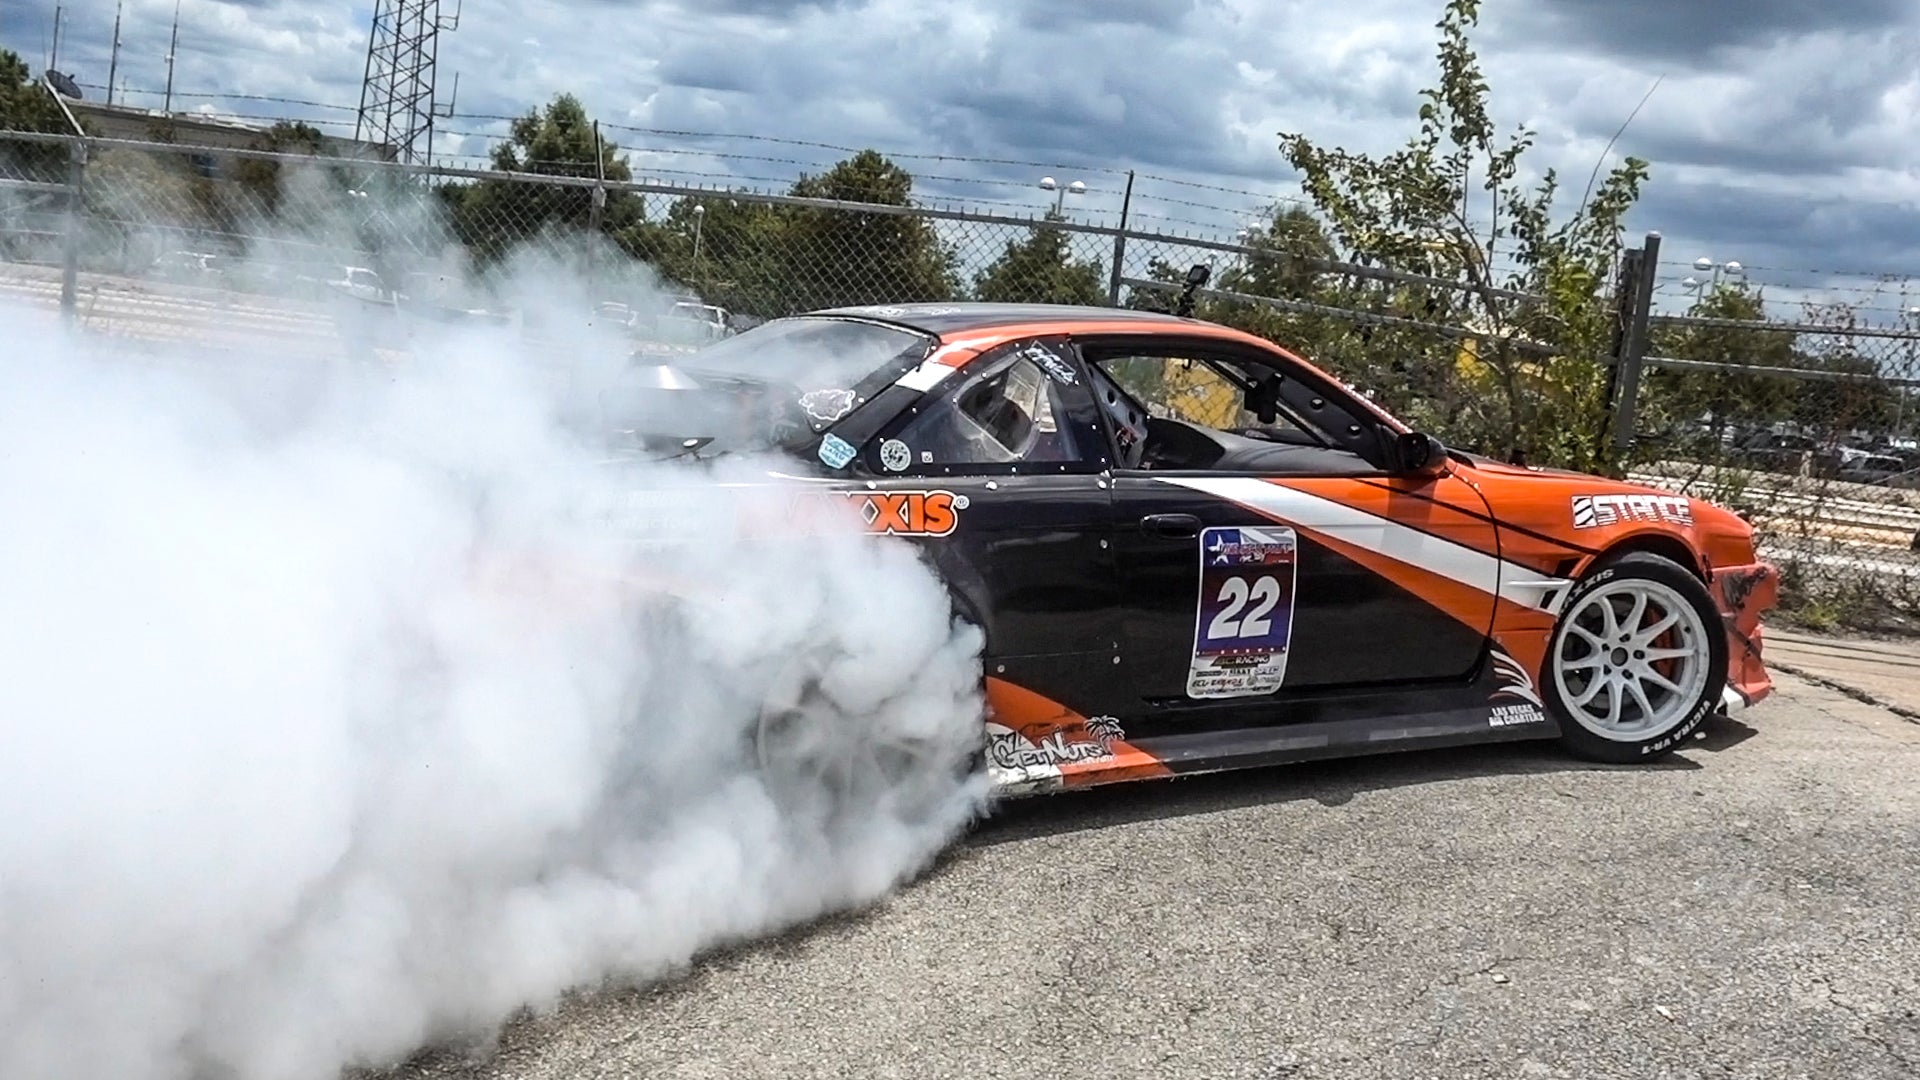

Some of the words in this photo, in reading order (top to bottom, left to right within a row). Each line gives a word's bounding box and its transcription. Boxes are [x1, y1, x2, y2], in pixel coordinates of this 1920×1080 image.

[1592, 495, 1693, 526] STANCE
[1207, 575, 1280, 640] 22
[1235, 654, 1270, 665] RACING
[1491, 706, 1508, 717] LAS
[1507, 704, 1534, 715] VEGAS
[1503, 712, 1545, 725] CHARTERS
[1673, 700, 1711, 740] VICTRA
